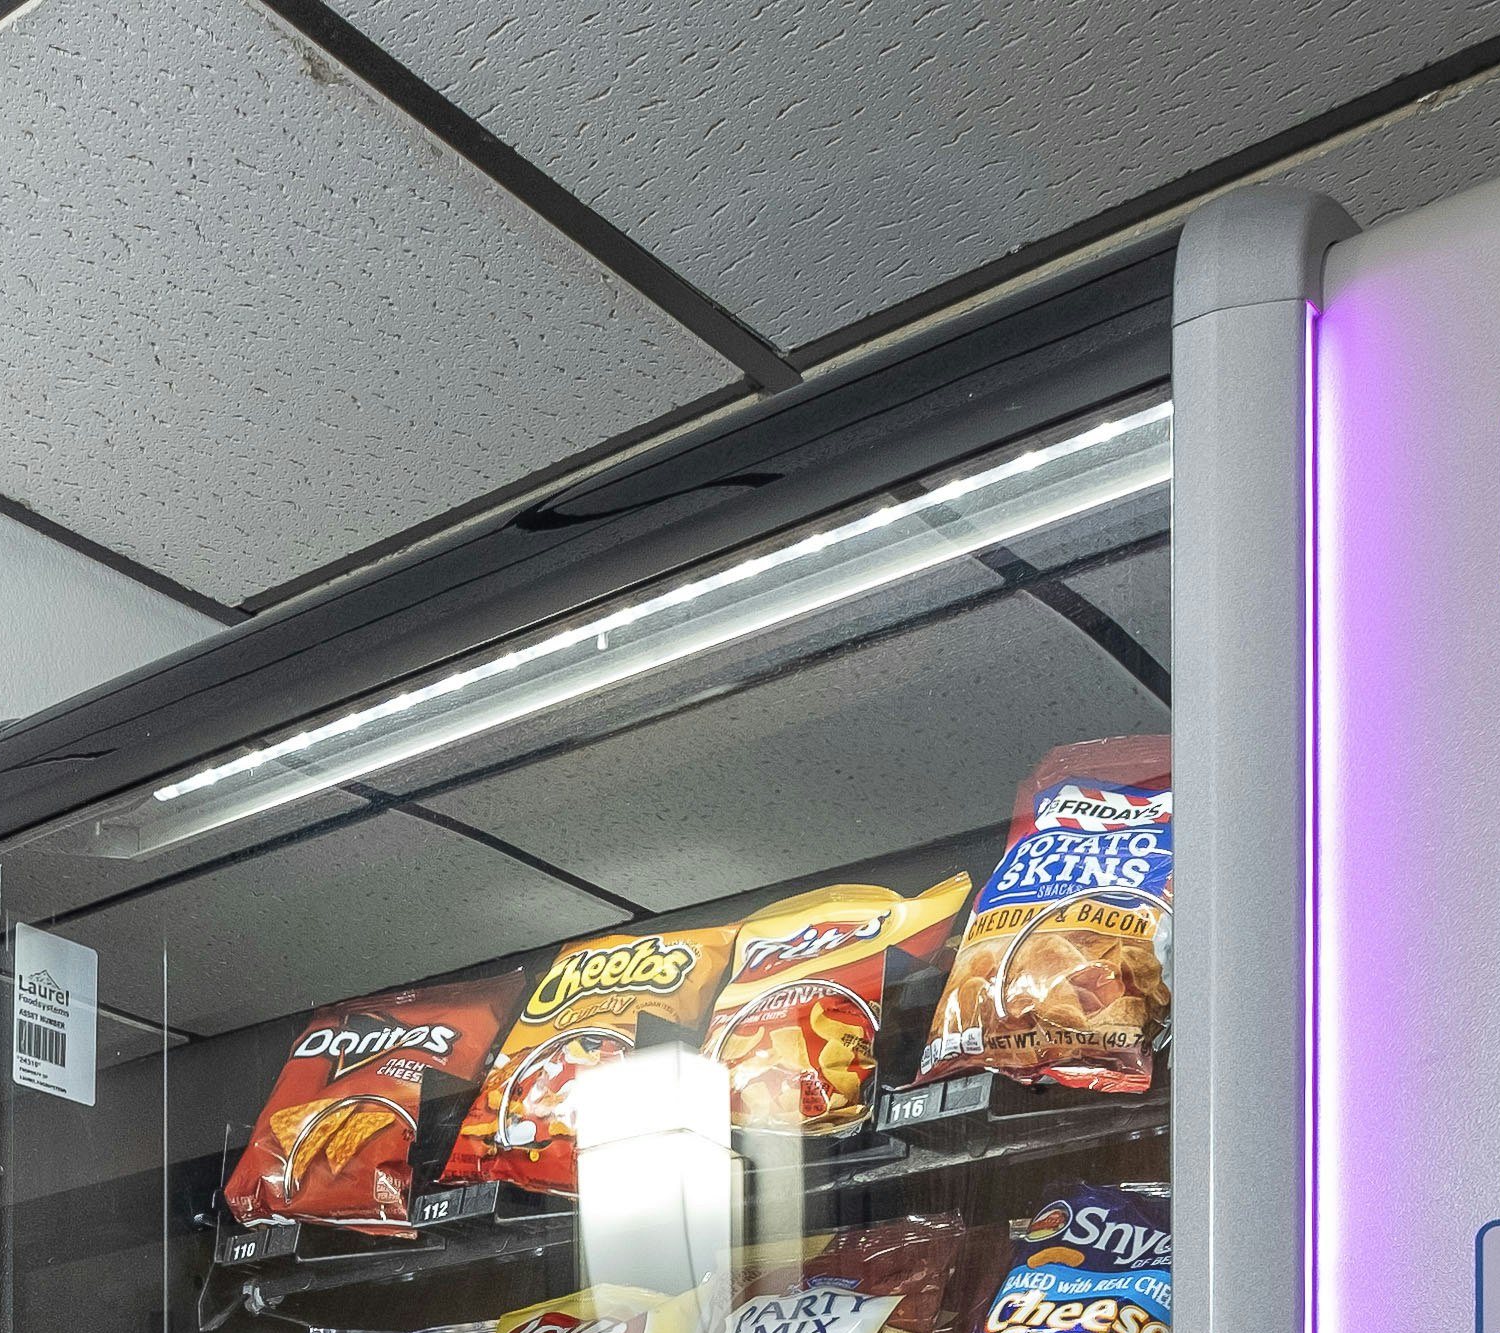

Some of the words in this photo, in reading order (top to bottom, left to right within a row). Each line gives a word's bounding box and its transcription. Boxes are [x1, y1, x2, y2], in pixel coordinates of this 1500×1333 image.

[1015, 833, 1158, 862] POTATO
[997, 856, 1152, 889] SKINS
[1077, 903, 1149, 935] BACON
[18, 974, 70, 1007] Laurel
[521, 938, 693, 1019] Cheetos
[294, 1025, 460, 1059] Doritos
[891, 1098, 925, 1119] 116
[233, 1242, 257, 1261] 110
[733, 1294, 869, 1333] PARTY
